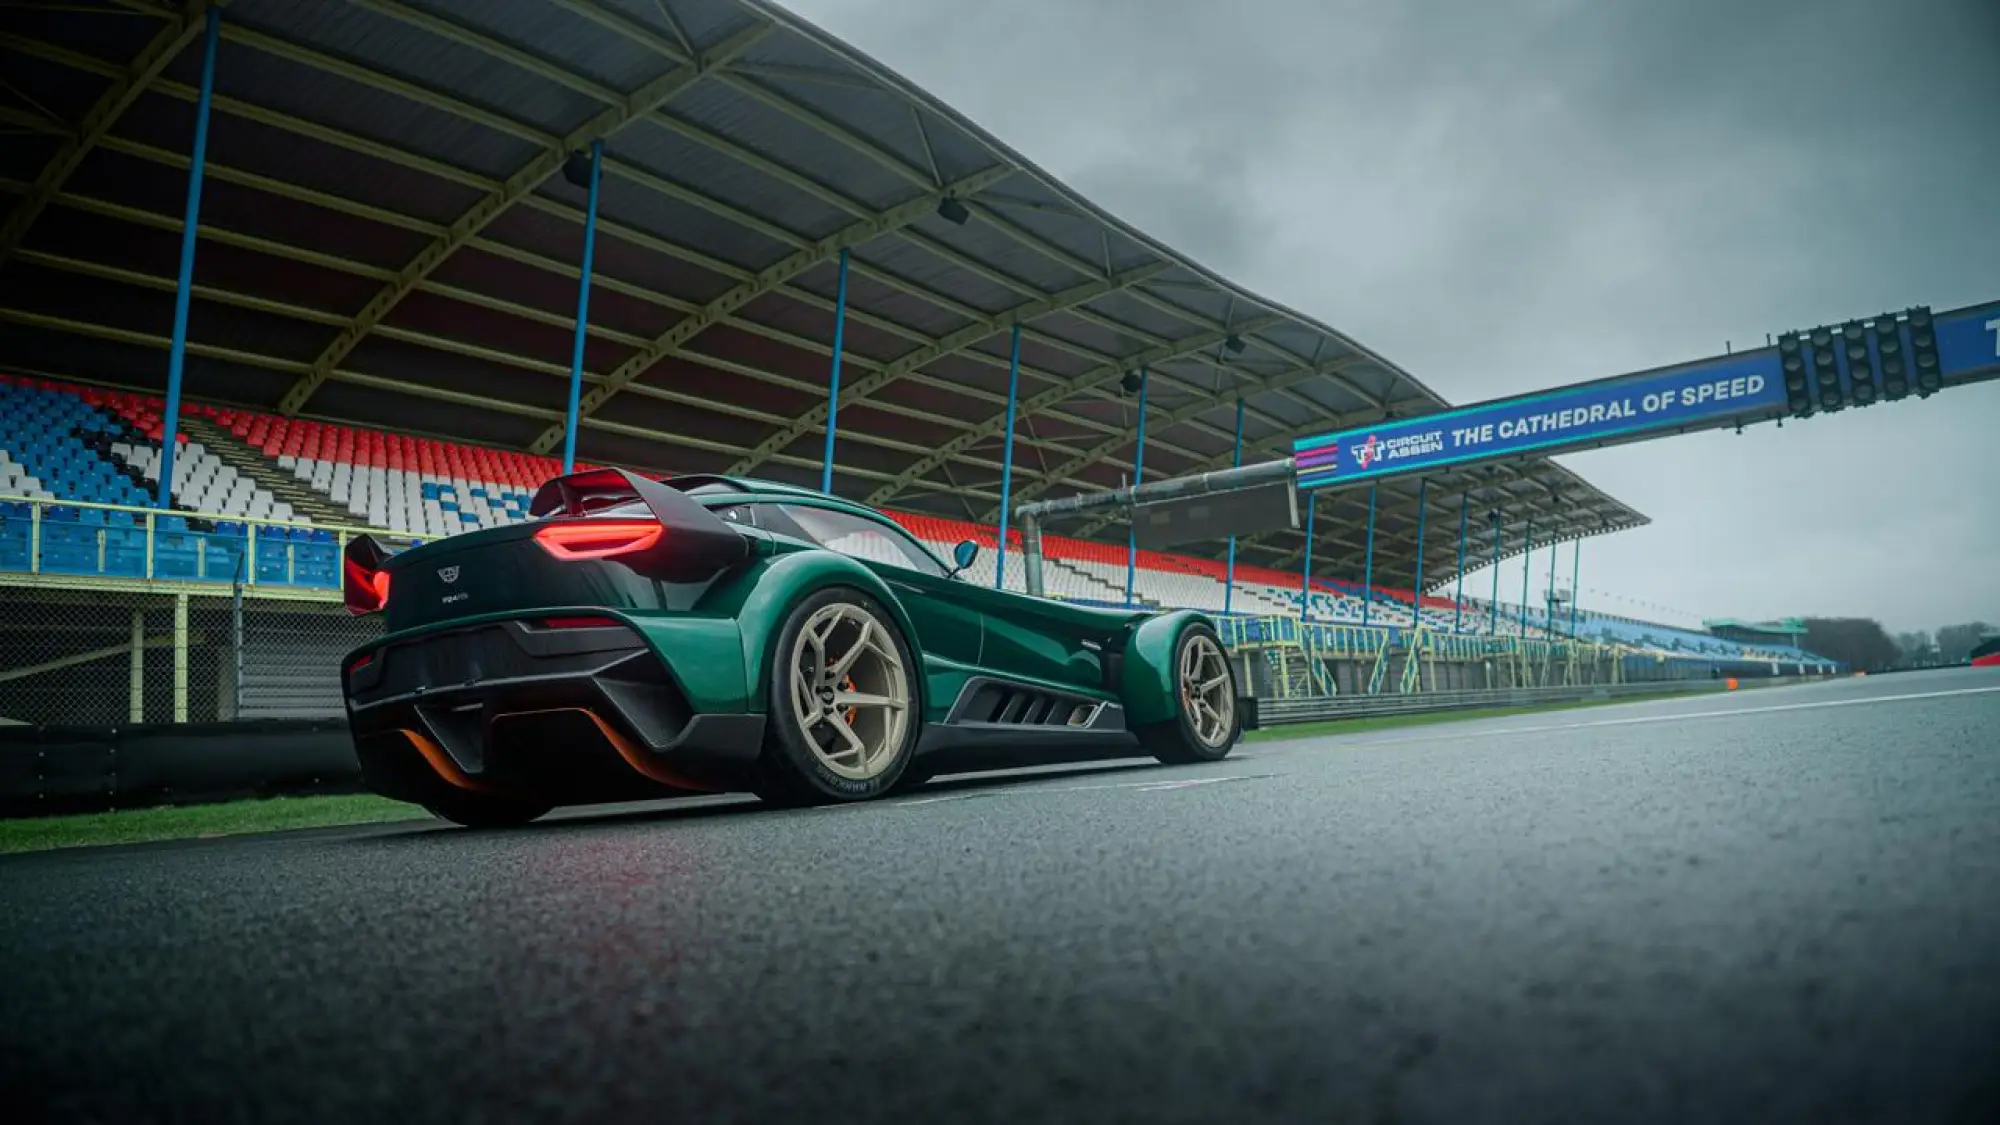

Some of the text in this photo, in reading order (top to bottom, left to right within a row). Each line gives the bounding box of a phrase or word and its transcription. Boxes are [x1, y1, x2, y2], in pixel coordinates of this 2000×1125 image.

[1451, 375, 1765, 447] THE CATHEDRAL OF SPEED
[1387, 431, 1443, 449] CIRCUIT
[1388, 440, 1444, 459] ASSEN
